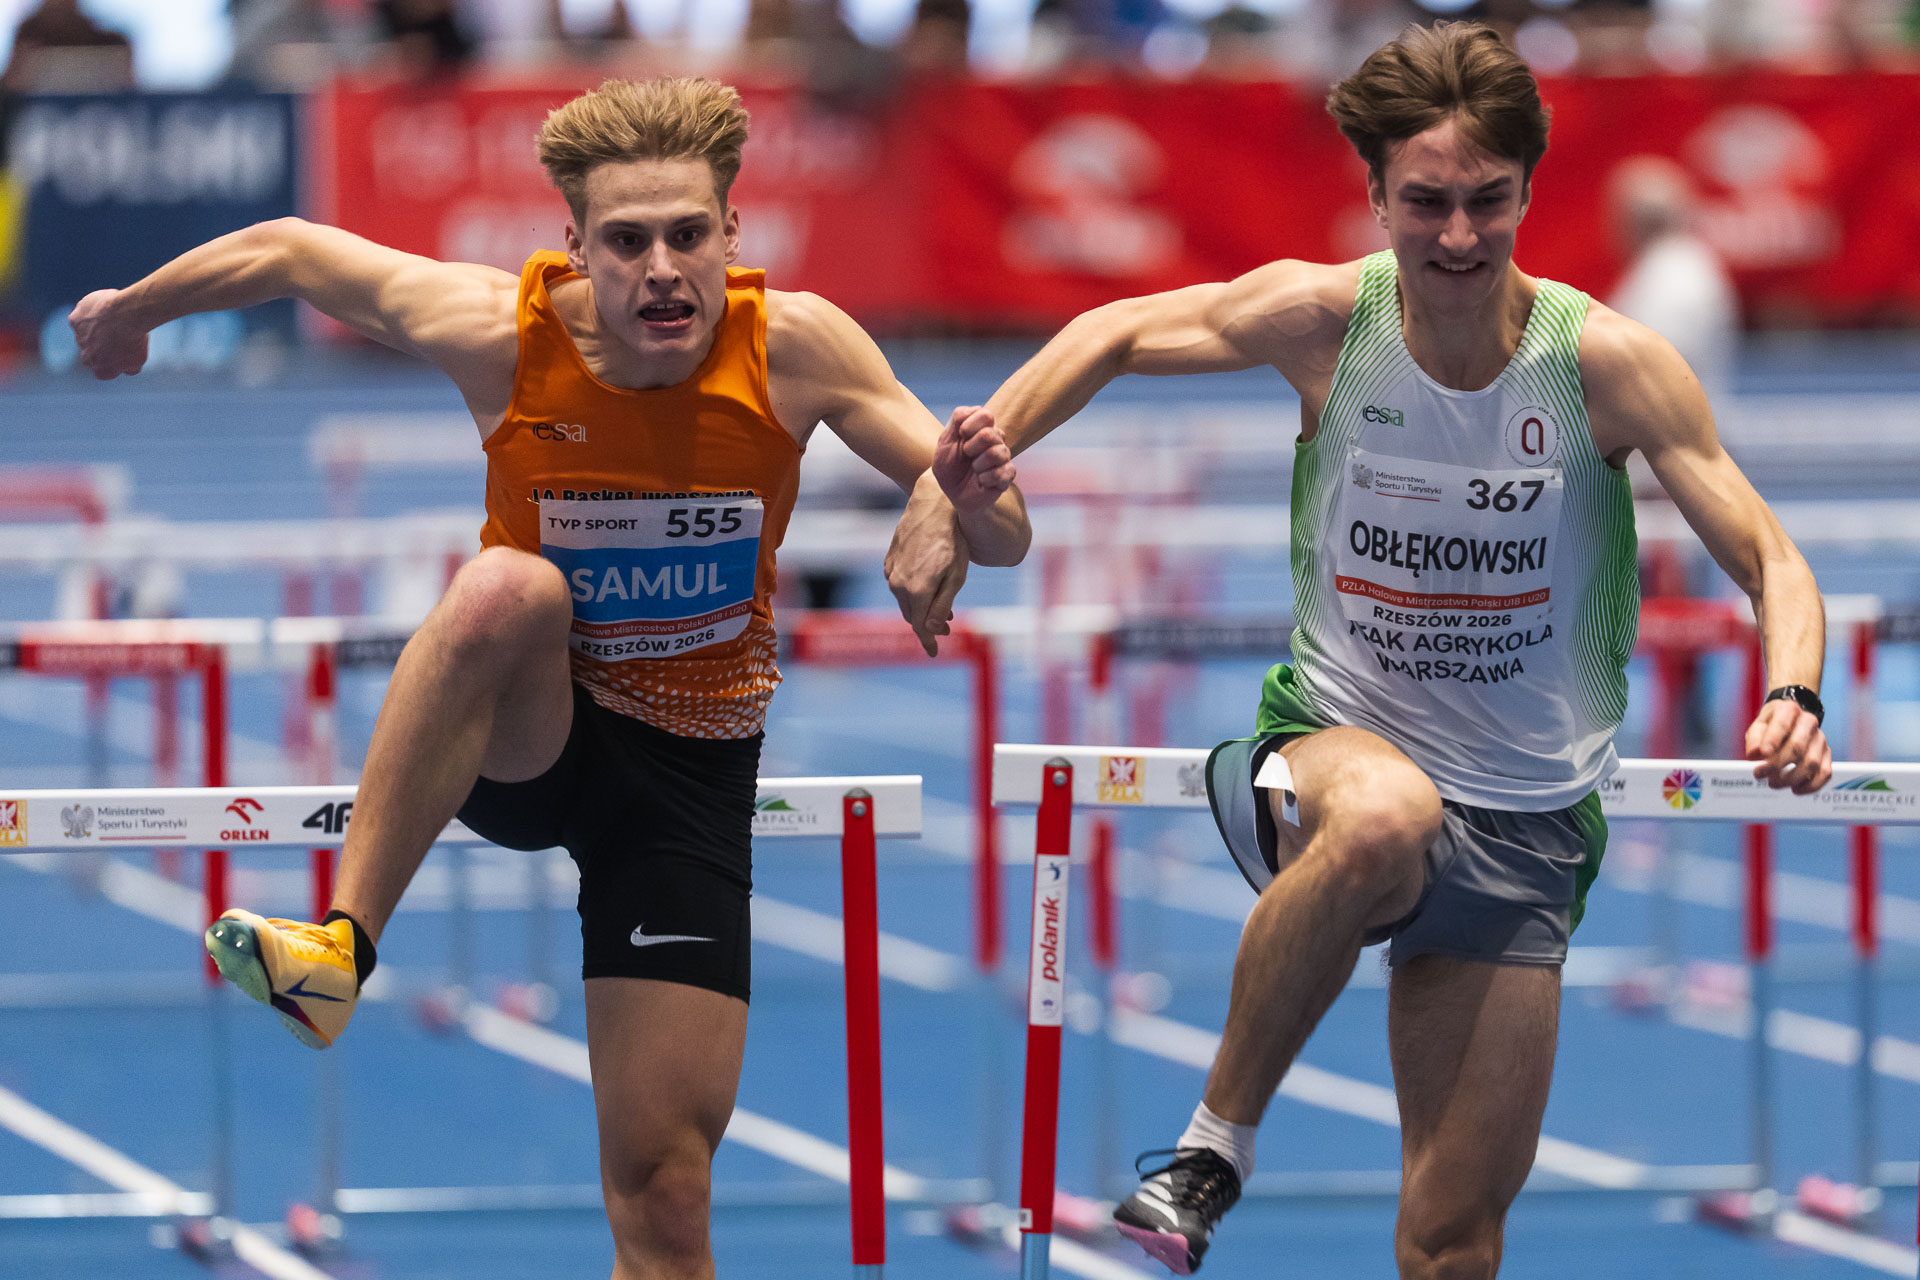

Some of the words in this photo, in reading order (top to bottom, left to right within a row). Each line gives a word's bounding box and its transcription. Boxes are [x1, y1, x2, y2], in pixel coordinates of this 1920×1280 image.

[1362, 405, 1405, 427] esa
[532, 422, 588, 443] esa
[1375, 470, 1426, 484] Ministerstwo
[1375, 480, 1401, 491] Sportu
[1407, 483, 1442, 495] Turystyki
[1466, 478, 1545, 513] 367
[548, 517, 581, 530] TVP
[585, 518, 638, 530] SPORT
[665, 507, 742, 538] 555
[1350, 520, 1547, 578] OBŁĘKOWSKI
[570, 562, 727, 603] SAMUL
[1342, 580, 1366, 593] PZLA
[1368, 584, 1403, 603] Halowe
[1406, 596, 1469, 609] Mistrzostwa
[1471, 597, 1501, 608] Polski
[1503, 598, 1520, 607] U18
[1528, 592, 1546, 603] U20
[574, 623, 611, 638] Halowe
[613, 623, 675, 635] Mistrzostwa
[677, 618, 706, 631] Polski
[707, 613, 723, 624] U18
[729, 604, 748, 616] U20
[1373, 605, 1463, 627] RZESZÓW
[1467, 614, 1512, 627] 2026
[581, 637, 670, 657] RZESZÓW
[674, 629, 716, 650] 2026
[1413, 624, 1553, 656] AGRYKOLA
[1376, 652, 1524, 684] WARSZAWA
[98, 806, 165, 816] Ministerstwo
[1813, 791, 1916, 806] PODKARPACKIE
[98, 819, 133, 832] Sportu
[141, 817, 188, 831] Turystyki
[220, 829, 269, 841] ORLEN
[1040, 897, 1060, 983] polanik
